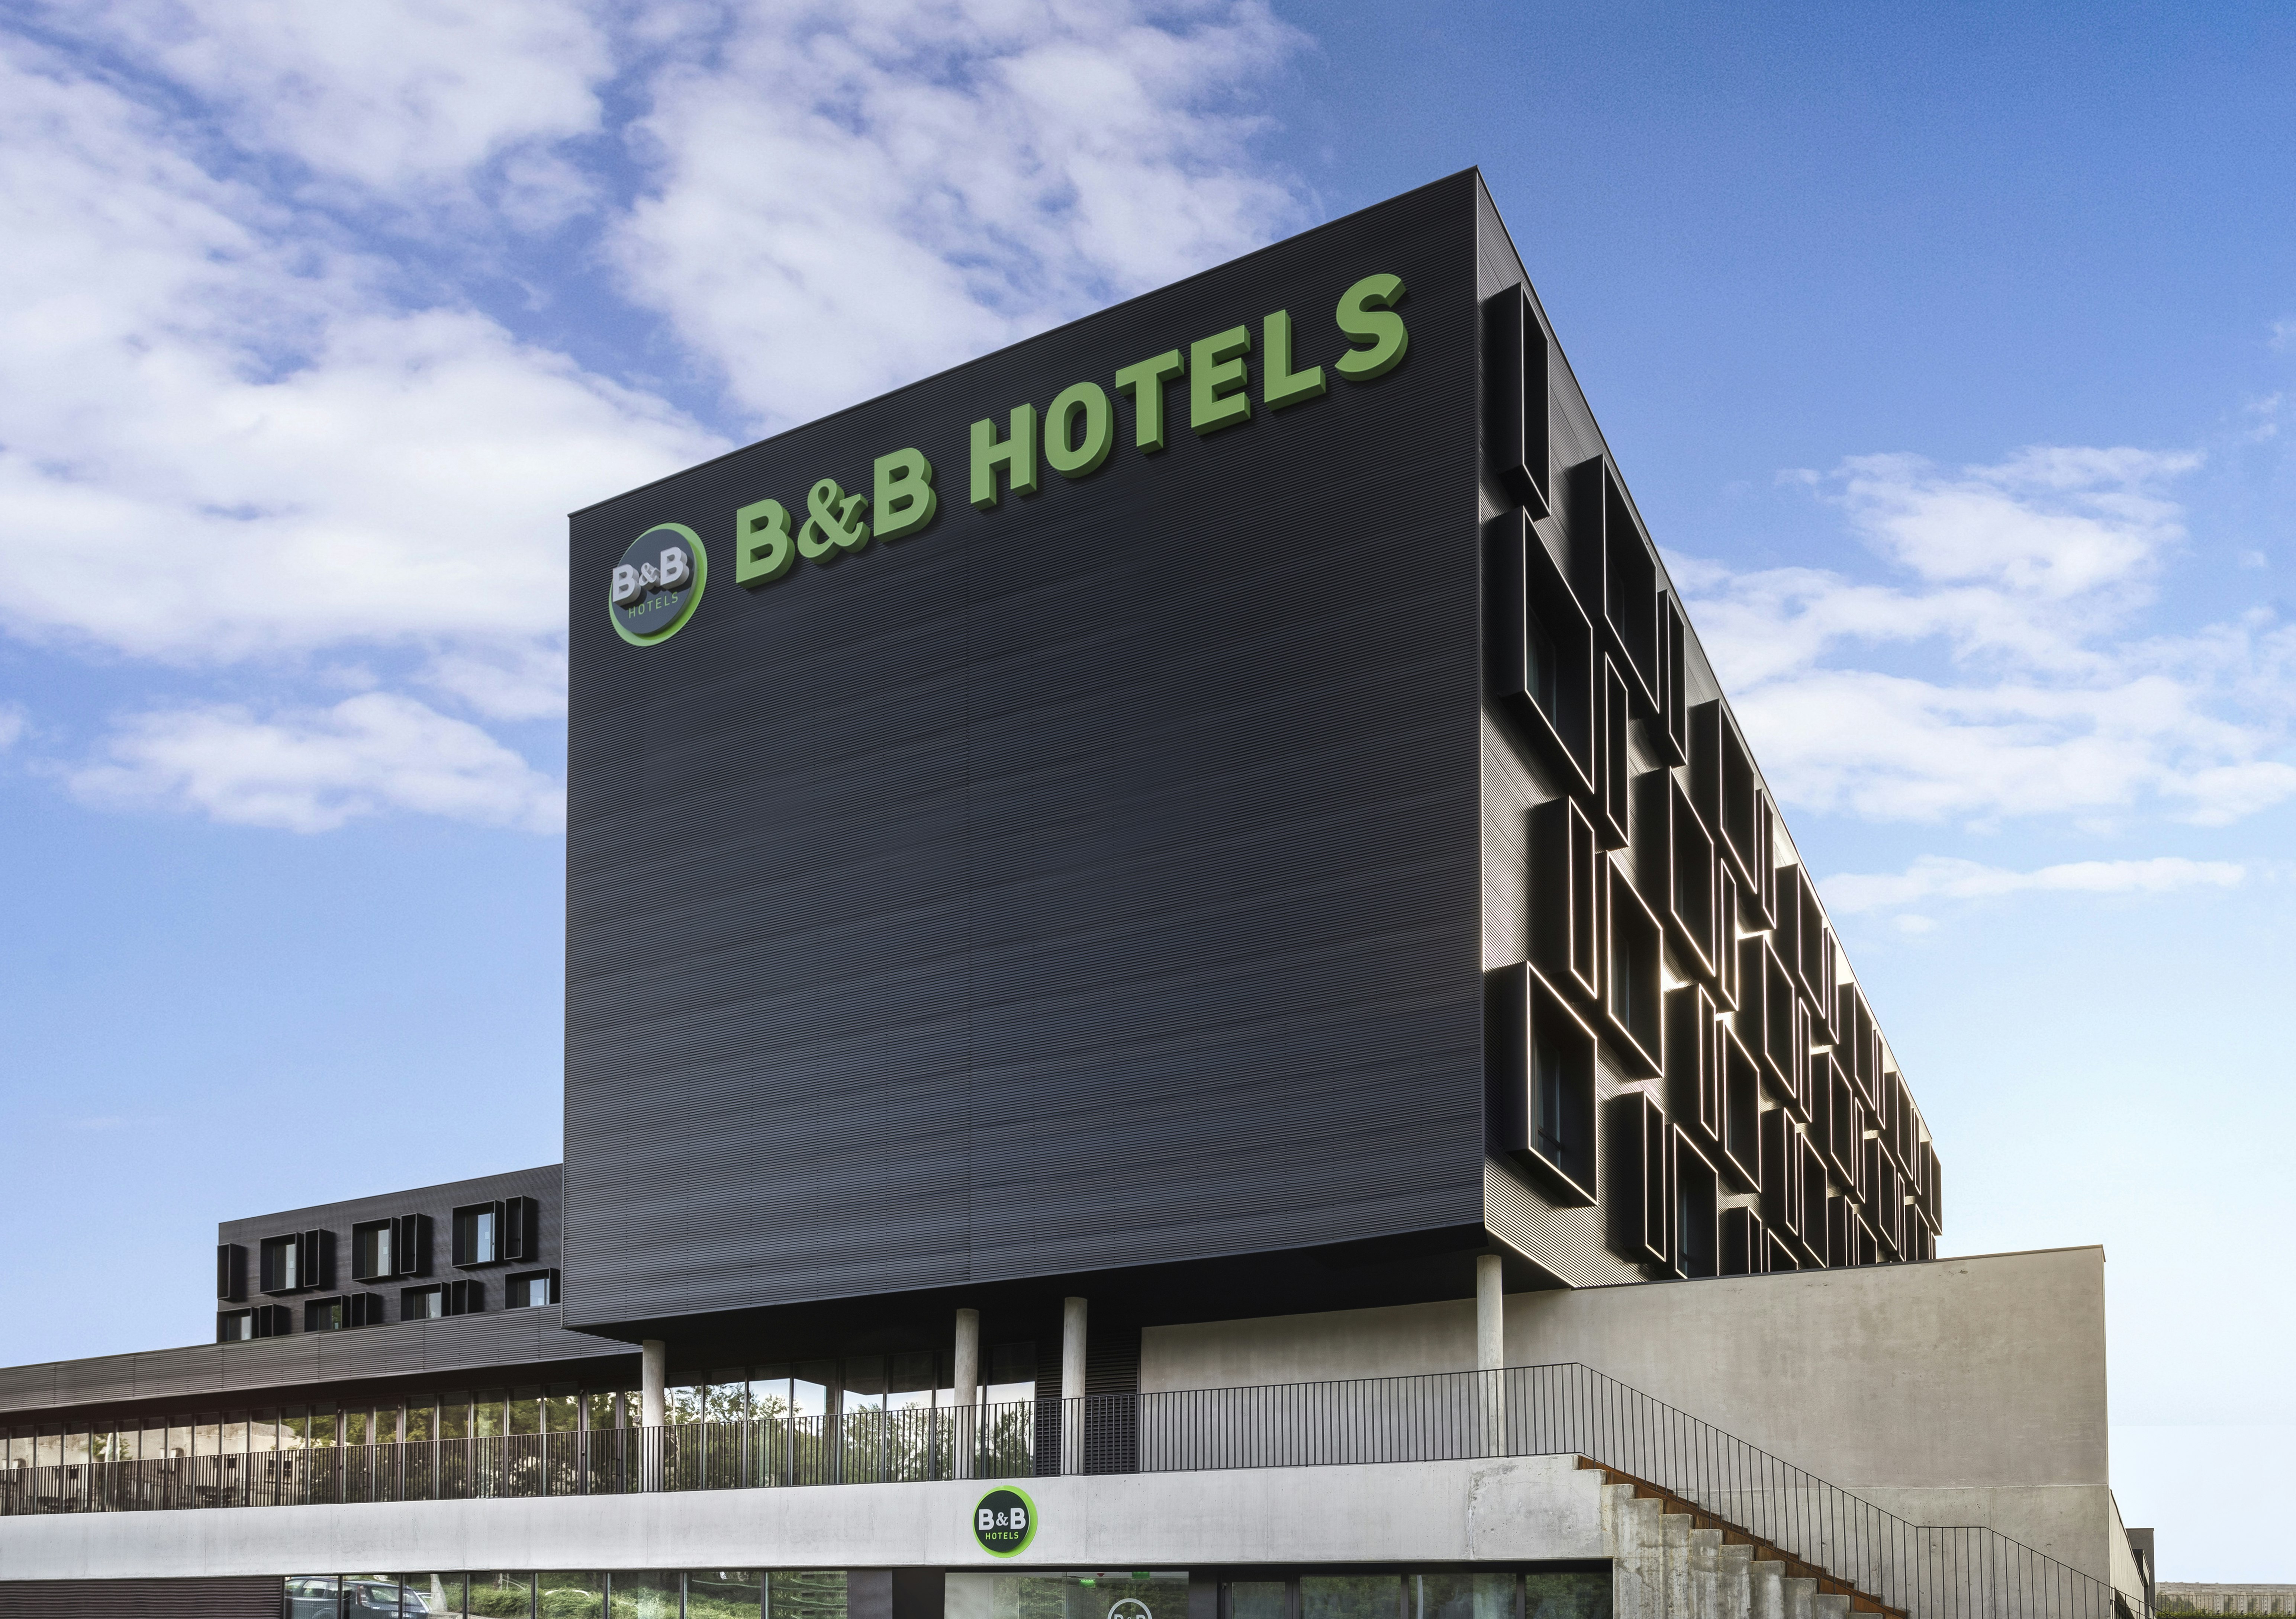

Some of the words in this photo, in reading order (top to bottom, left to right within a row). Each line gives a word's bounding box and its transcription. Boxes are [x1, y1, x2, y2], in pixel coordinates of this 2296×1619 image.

[736, 447, 936, 589] B&B
[970, 273, 1408, 512] HOTELS
[612, 546, 689, 606] B&B
[628, 592, 679, 619] HOTELS
[979, 1507, 1026, 1530] B&B
[985, 1532, 1019, 1540] HOTELS
